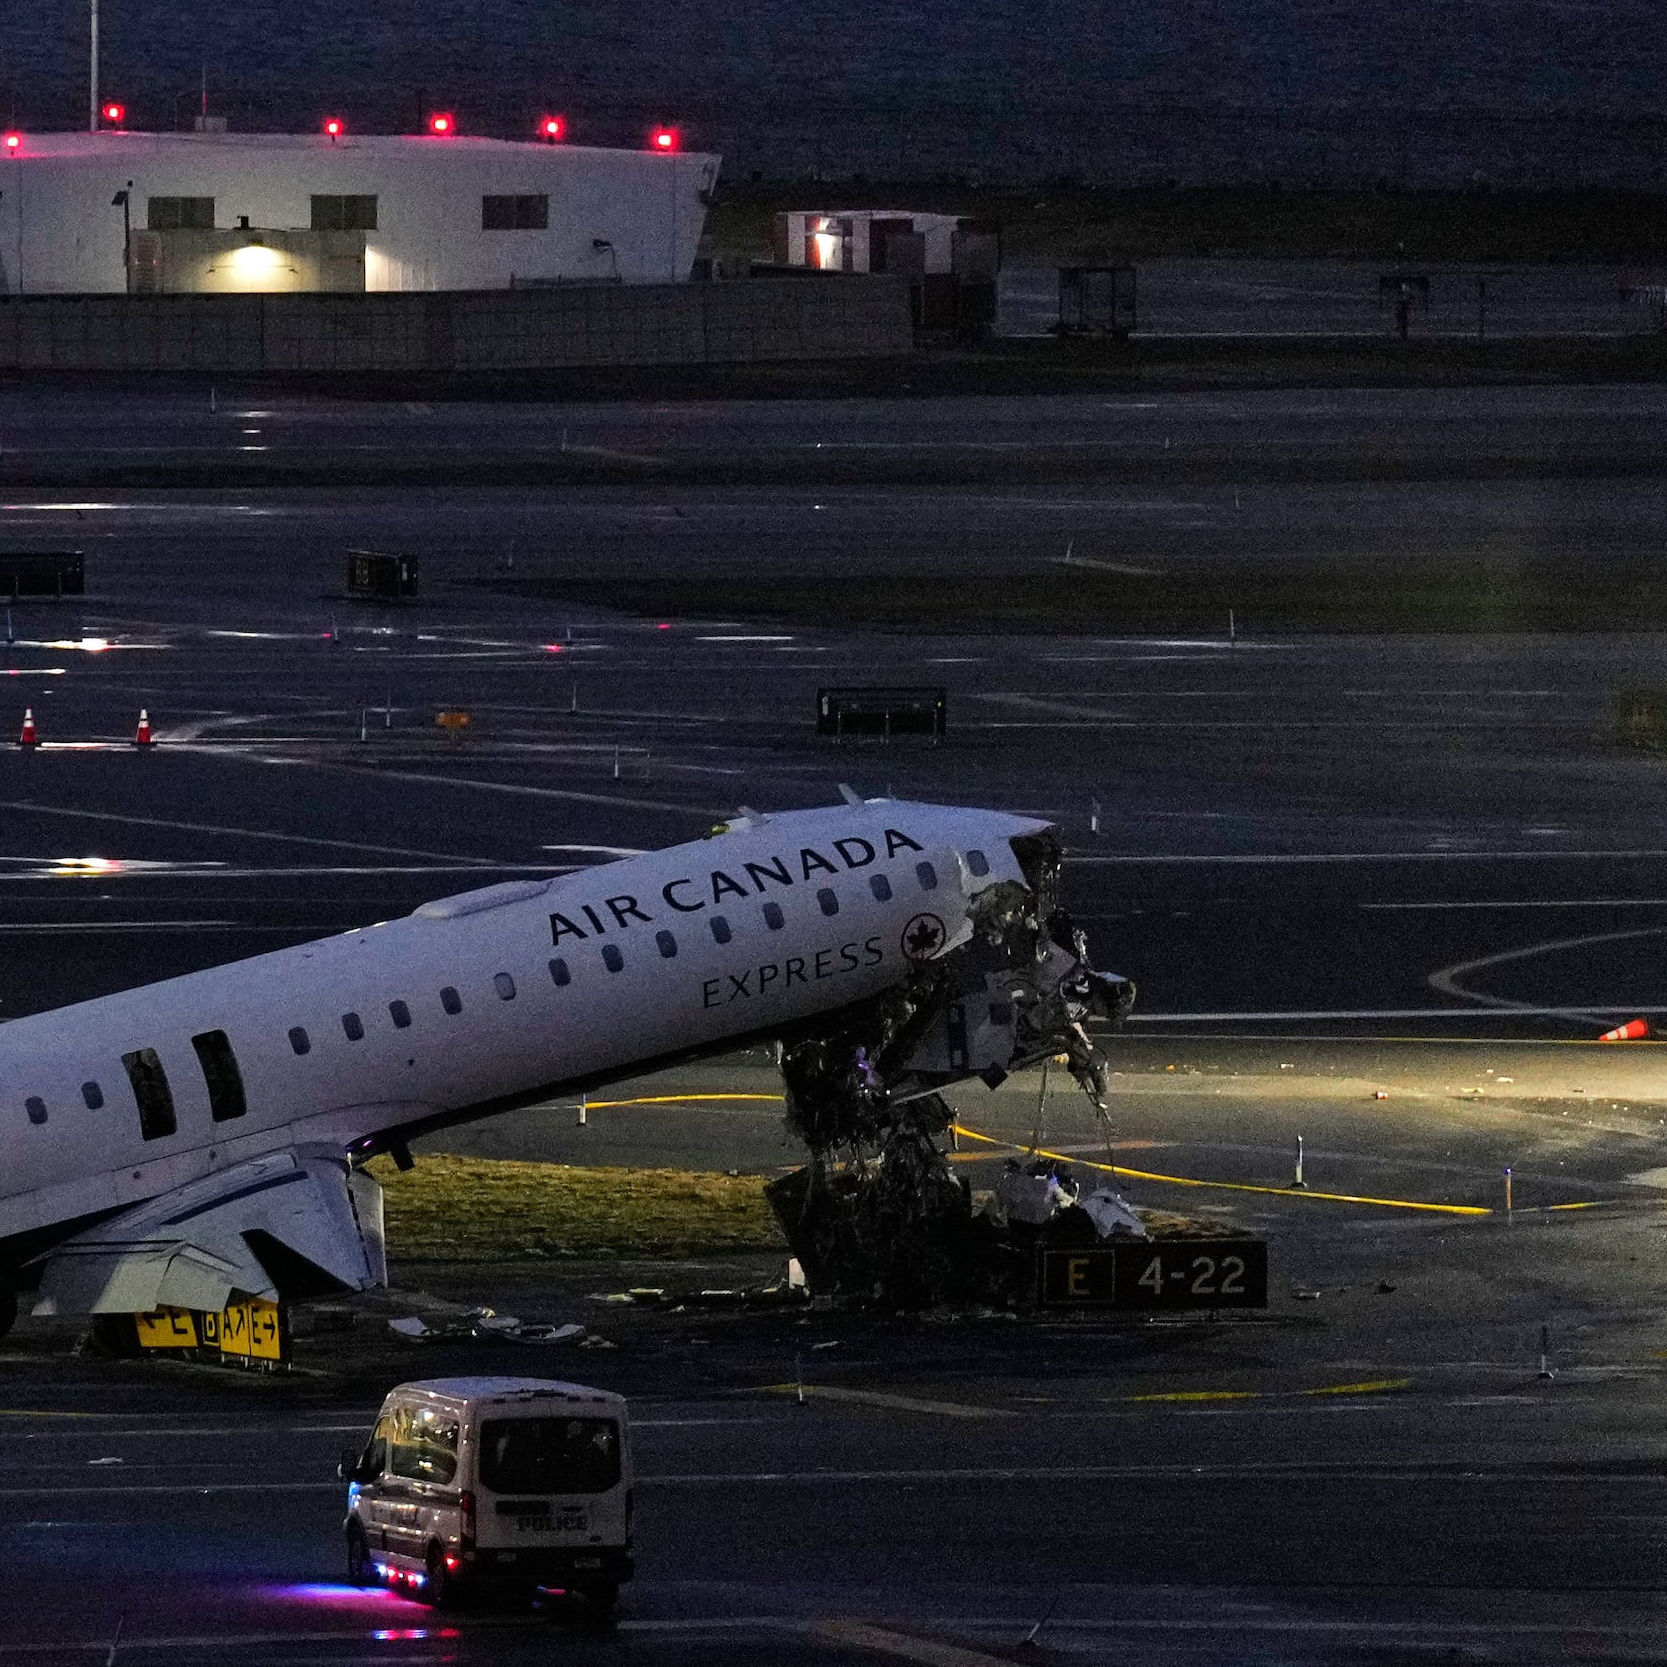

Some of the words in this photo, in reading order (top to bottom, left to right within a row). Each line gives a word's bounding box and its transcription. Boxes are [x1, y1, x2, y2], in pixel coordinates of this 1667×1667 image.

[548, 894, 654, 946] AIR
[661, 828, 924, 912] CANADA
[702, 936, 884, 1009] EXPRESS
[1068, 1257, 1091, 1296] E
[1137, 1255, 1246, 1295] 4-22
[223, 1307, 234, 1341] A
[251, 1306, 262, 1344] E
[517, 1515, 588, 1531] POLICE
